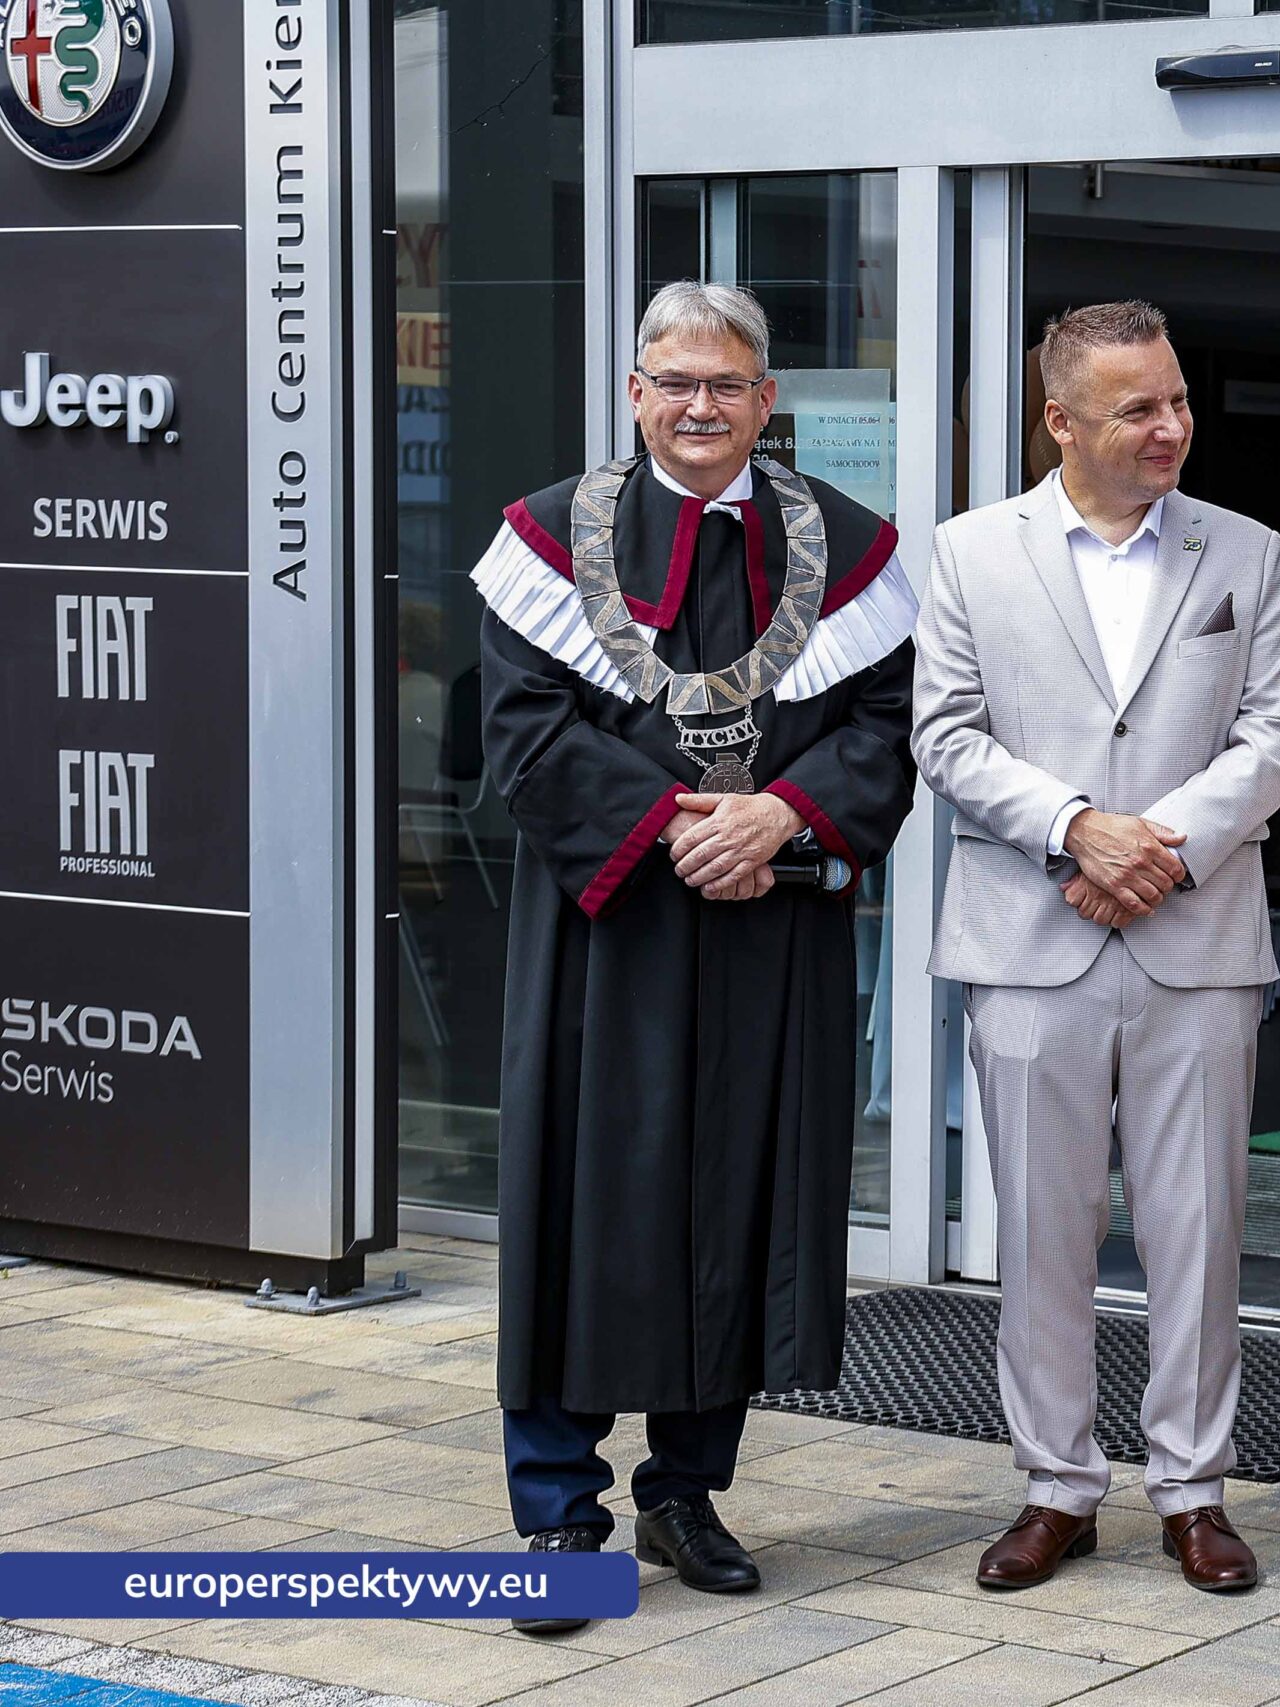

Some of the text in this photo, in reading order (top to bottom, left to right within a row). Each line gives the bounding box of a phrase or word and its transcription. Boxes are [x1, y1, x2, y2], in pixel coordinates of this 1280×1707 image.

[270, 145, 306, 424] Centrum
[0, 352, 178, 443] Jeep
[33, 497, 168, 541] SERWIS
[272, 450, 307, 602] Auto
[55, 594, 154, 701] FIAT
[683, 721, 753, 747] TYCHY
[58, 749, 155, 856] FIAT
[60, 856, 156, 878] PROFESSIONAL
[0, 1050, 115, 1103] Serwis
